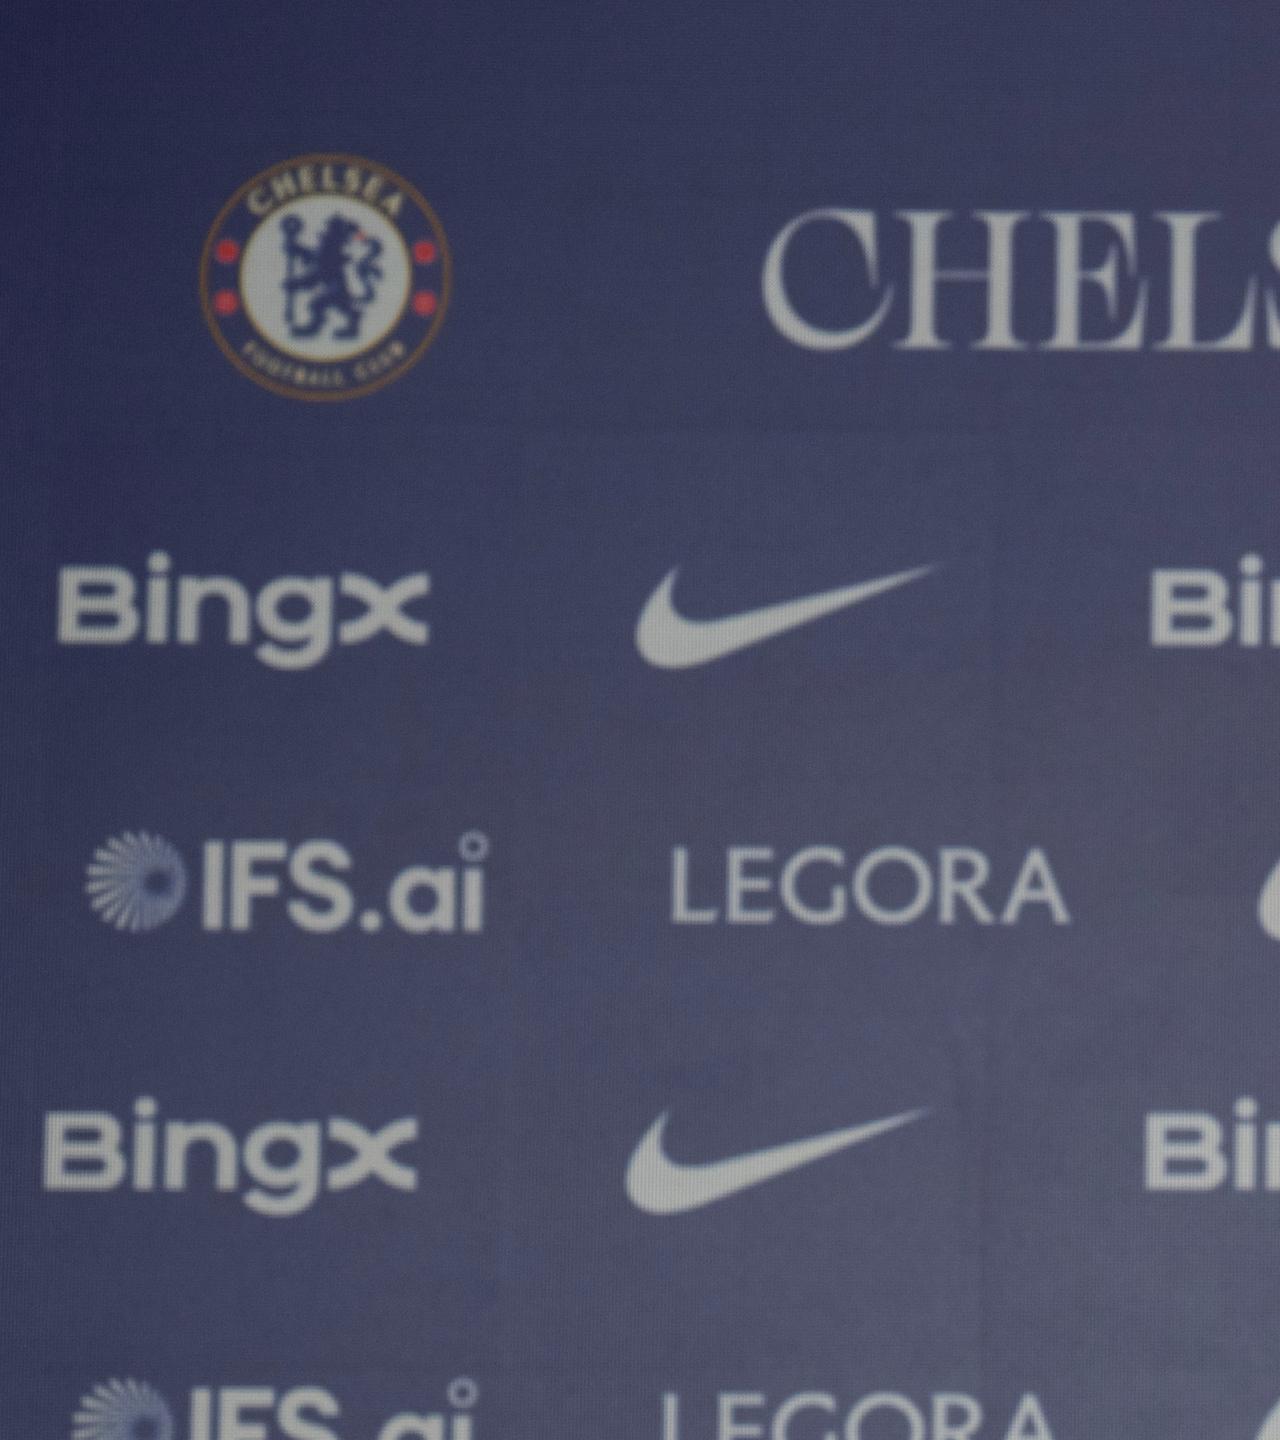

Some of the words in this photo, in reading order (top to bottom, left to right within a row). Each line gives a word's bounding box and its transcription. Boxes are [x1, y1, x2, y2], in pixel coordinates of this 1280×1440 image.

[57, 551, 432, 671] Bingx
[203, 831, 489, 935] IFS.ai
[671, 845, 1071, 926] LEGORA
[43, 1096, 420, 1218] Bingx
